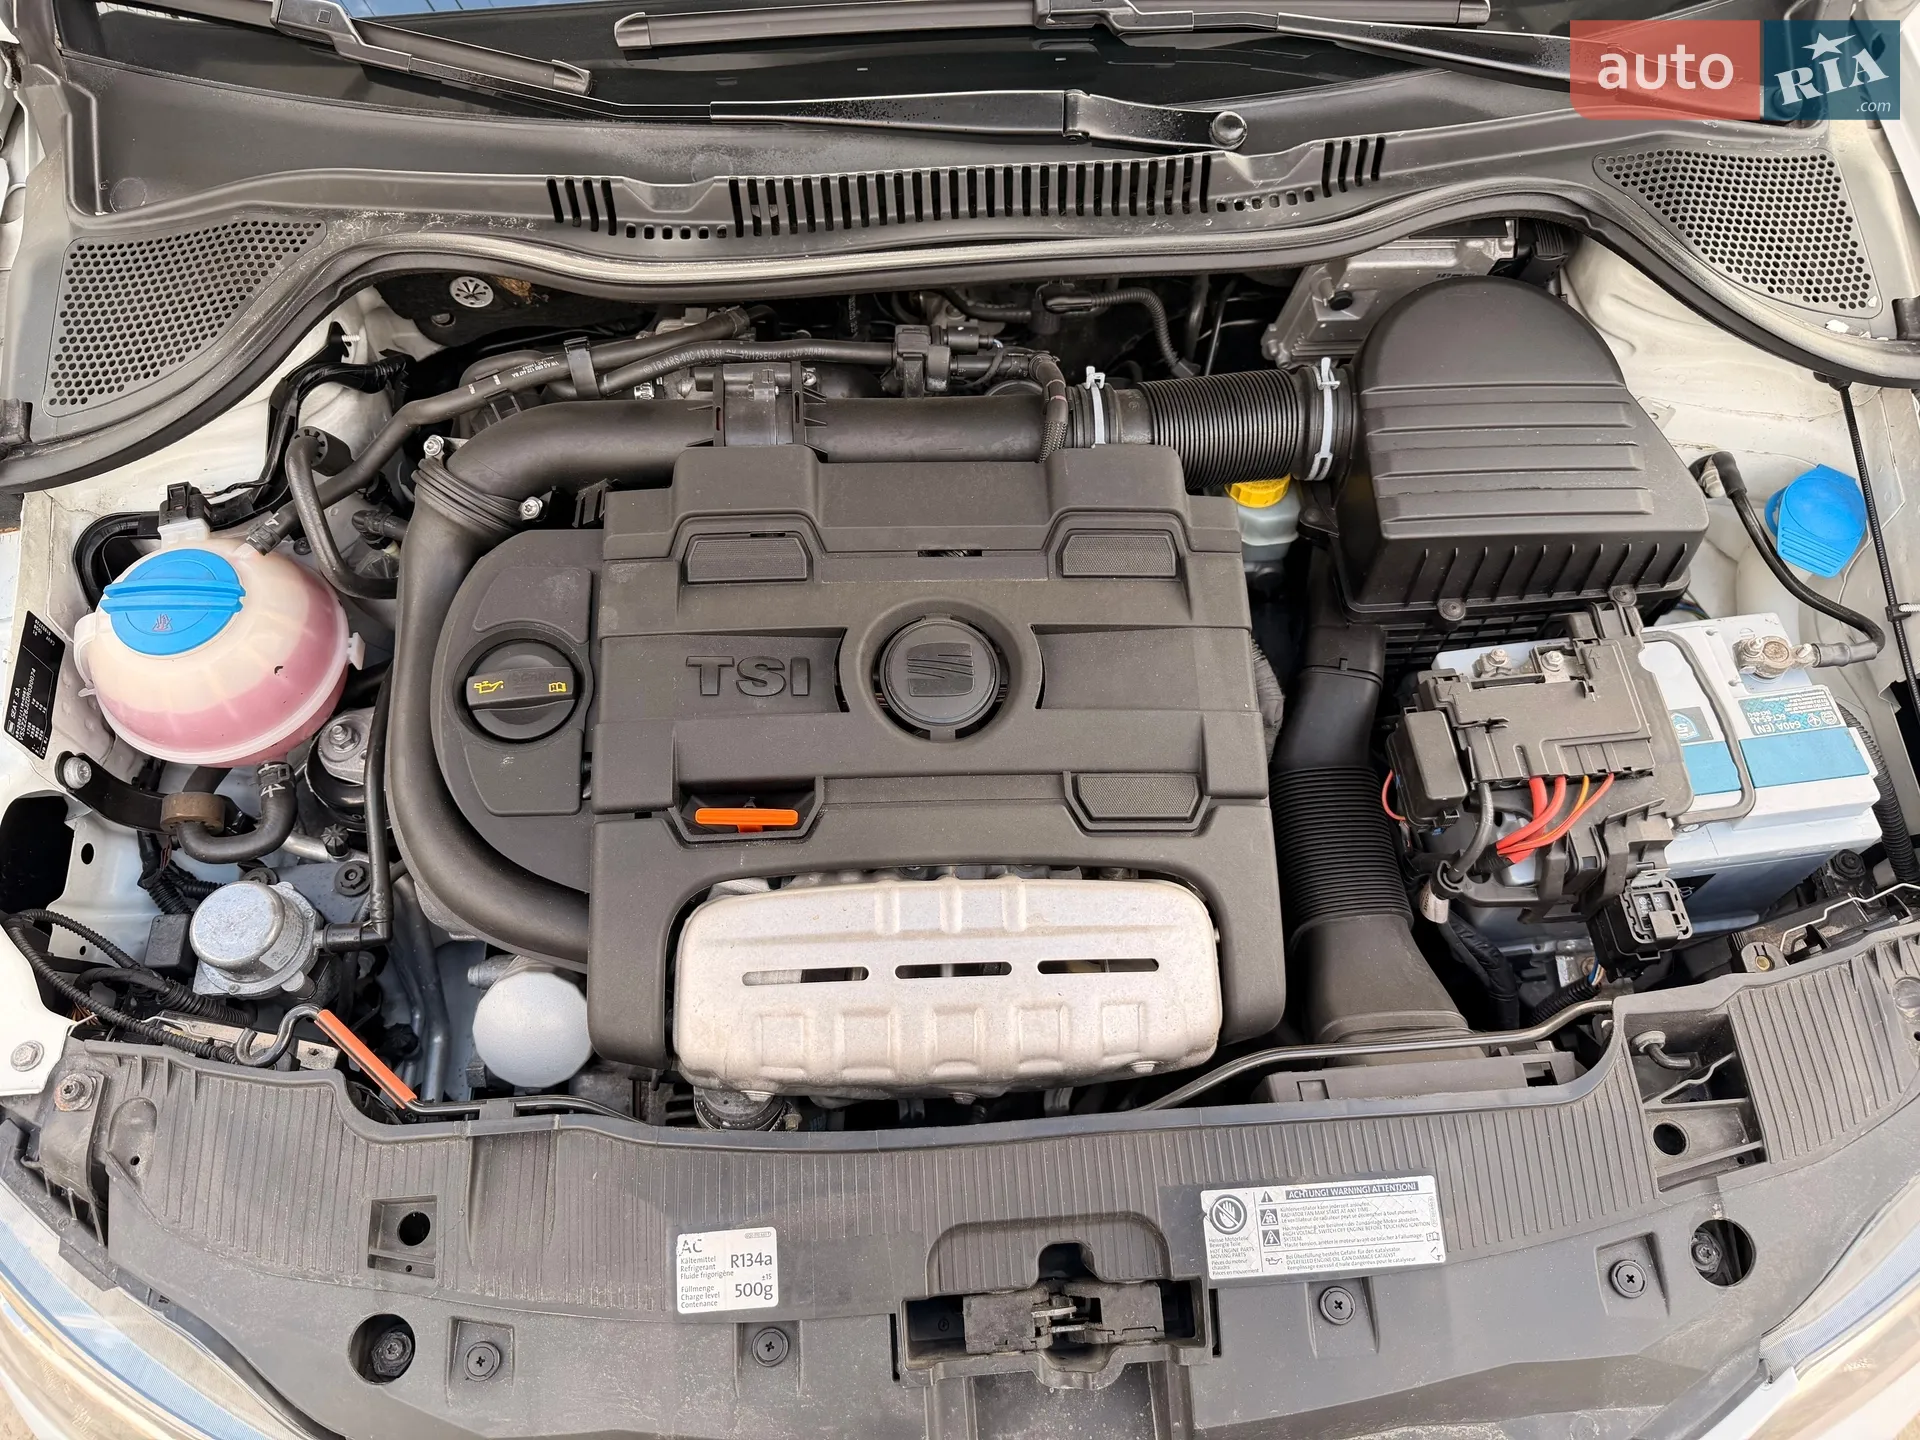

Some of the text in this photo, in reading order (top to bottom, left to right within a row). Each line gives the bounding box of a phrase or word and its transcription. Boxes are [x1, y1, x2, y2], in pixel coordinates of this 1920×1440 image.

[685, 656, 811, 697] TSI
[10, 685, 20, 720] SEAT SA
[1754, 720, 1801, 734] 640A (EN)
[1288, 1182, 1416, 1199] ACHTUNG! WARNING! ATTENTION!
[680, 1256, 716, 1265] Kältemittel
[730, 1251, 772, 1268] R134a
[1293, 1252, 1321, 1260] Überfüllung
[680, 1263, 715, 1274] Refrigerant
[701, 1270, 733, 1280] frigorigène
[681, 1284, 714, 1295] Füllmenge
[735, 1281, 773, 1303] 500g
[681, 1293, 703, 1302] Charge
[681, 1299, 717, 1309] Contenance
